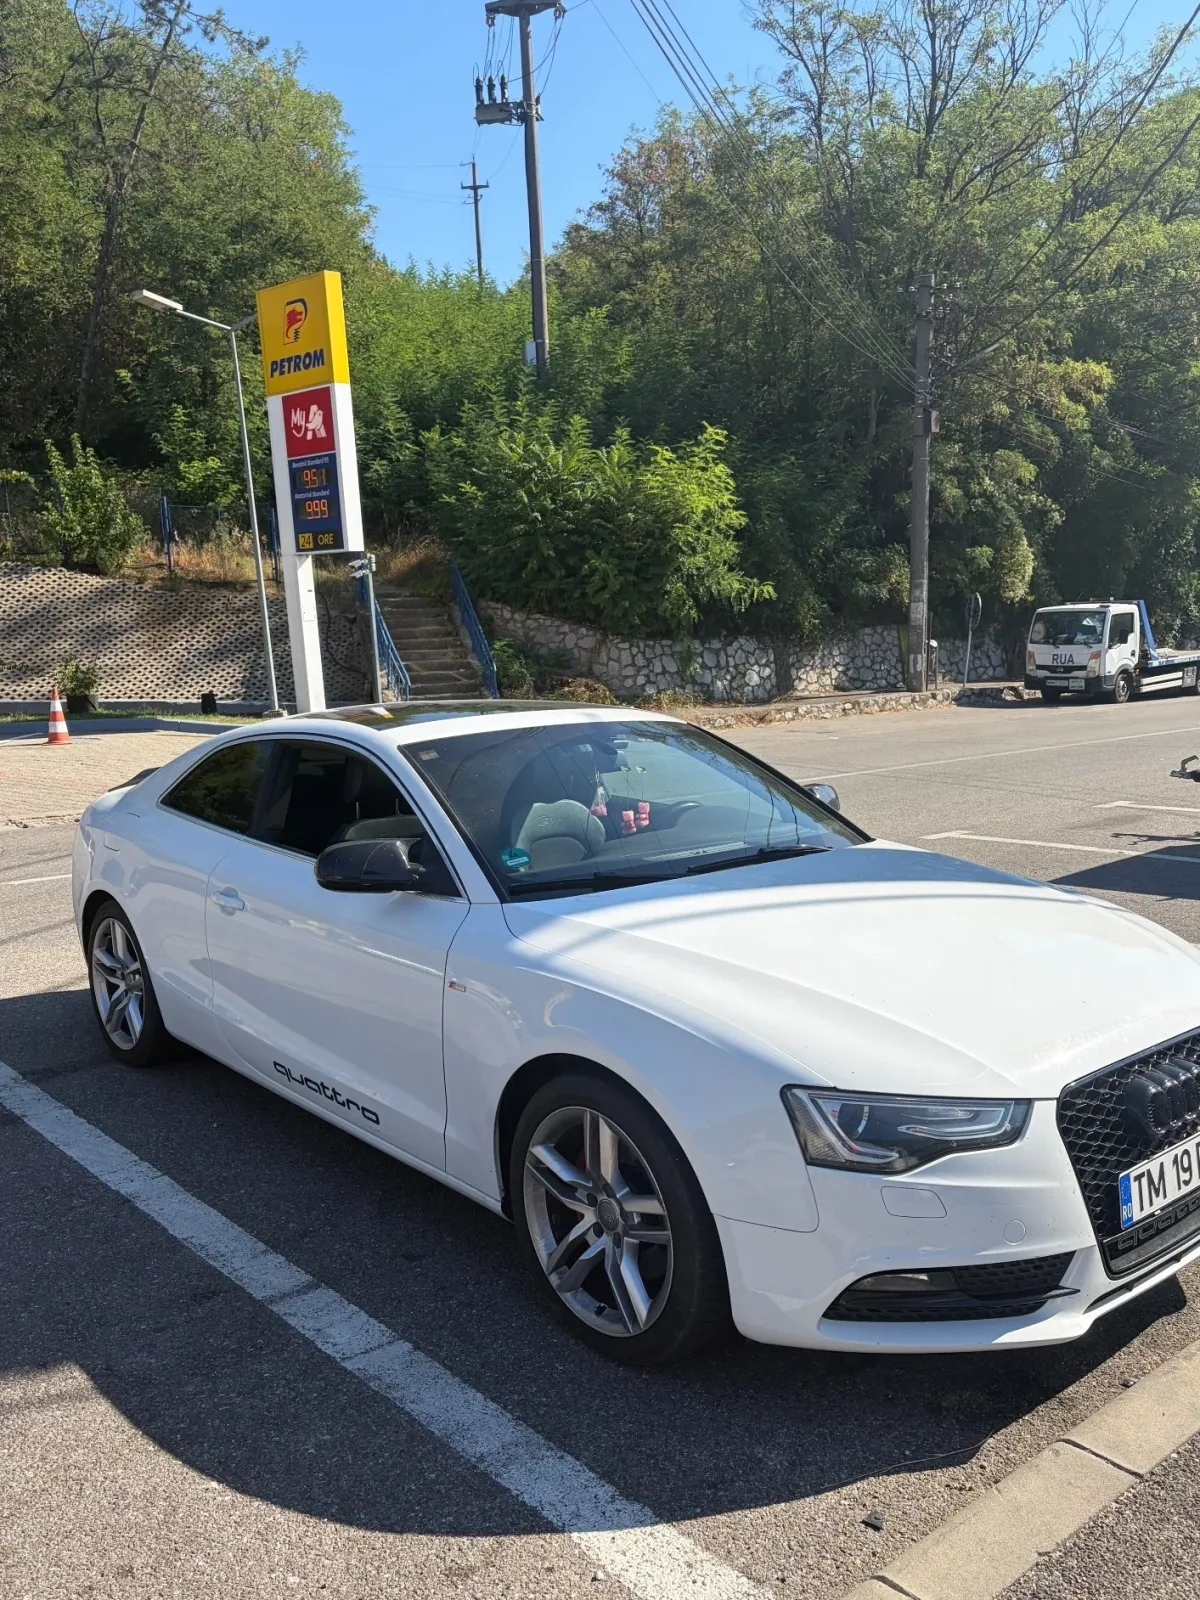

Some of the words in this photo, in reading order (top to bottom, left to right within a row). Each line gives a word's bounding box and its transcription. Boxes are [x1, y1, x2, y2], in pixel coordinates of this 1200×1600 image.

[270, 348, 325, 378] PETROM
[291, 407, 306, 437] My
[301, 535, 311, 547] 24
[318, 533, 334, 545] ORE
[1052, 653, 1075, 665] RUA
[273, 1060, 380, 1125] quattro
[1133, 1161, 1167, 1212] TM
[1172, 1148, 1193, 1192] 19
[1122, 1202, 1133, 1221] RO
